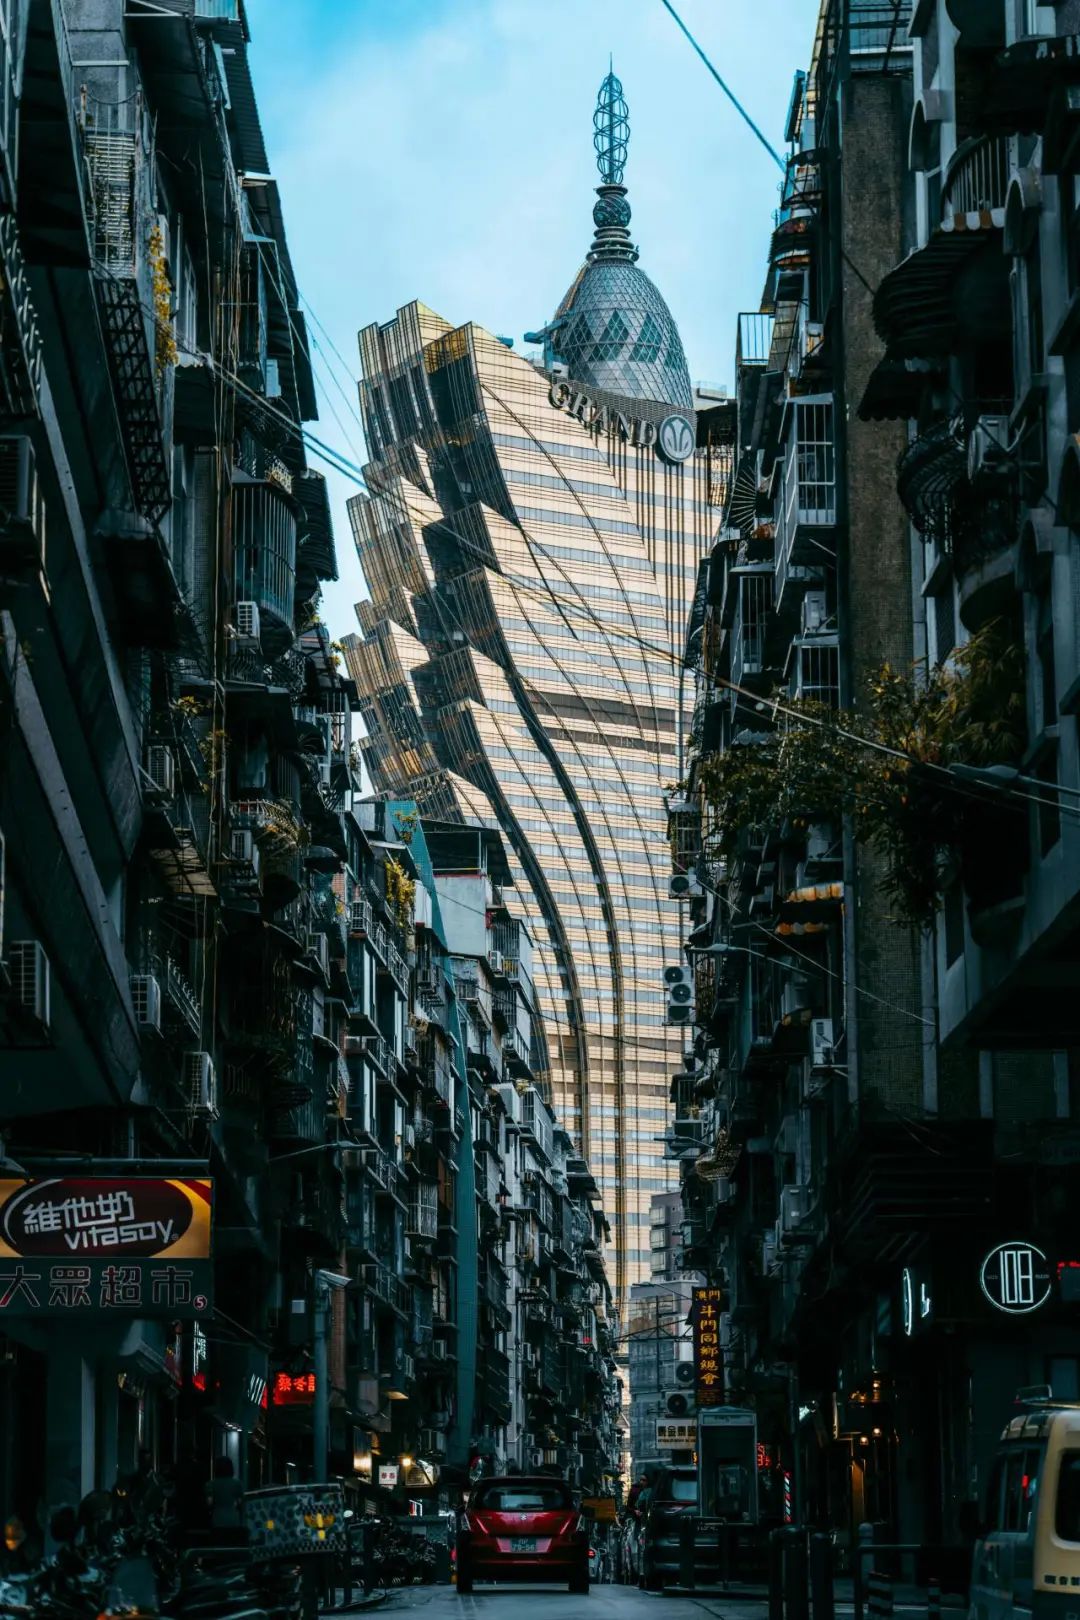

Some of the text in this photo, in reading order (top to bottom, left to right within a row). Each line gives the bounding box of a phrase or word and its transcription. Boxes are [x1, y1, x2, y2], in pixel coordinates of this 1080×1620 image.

[548, 382, 658, 447] GRAND
[22, 1190, 135, 1235] 維他奶
[0, 1265, 206, 1310] 大眾超市 5
[999, 1249, 1035, 1305] 108
